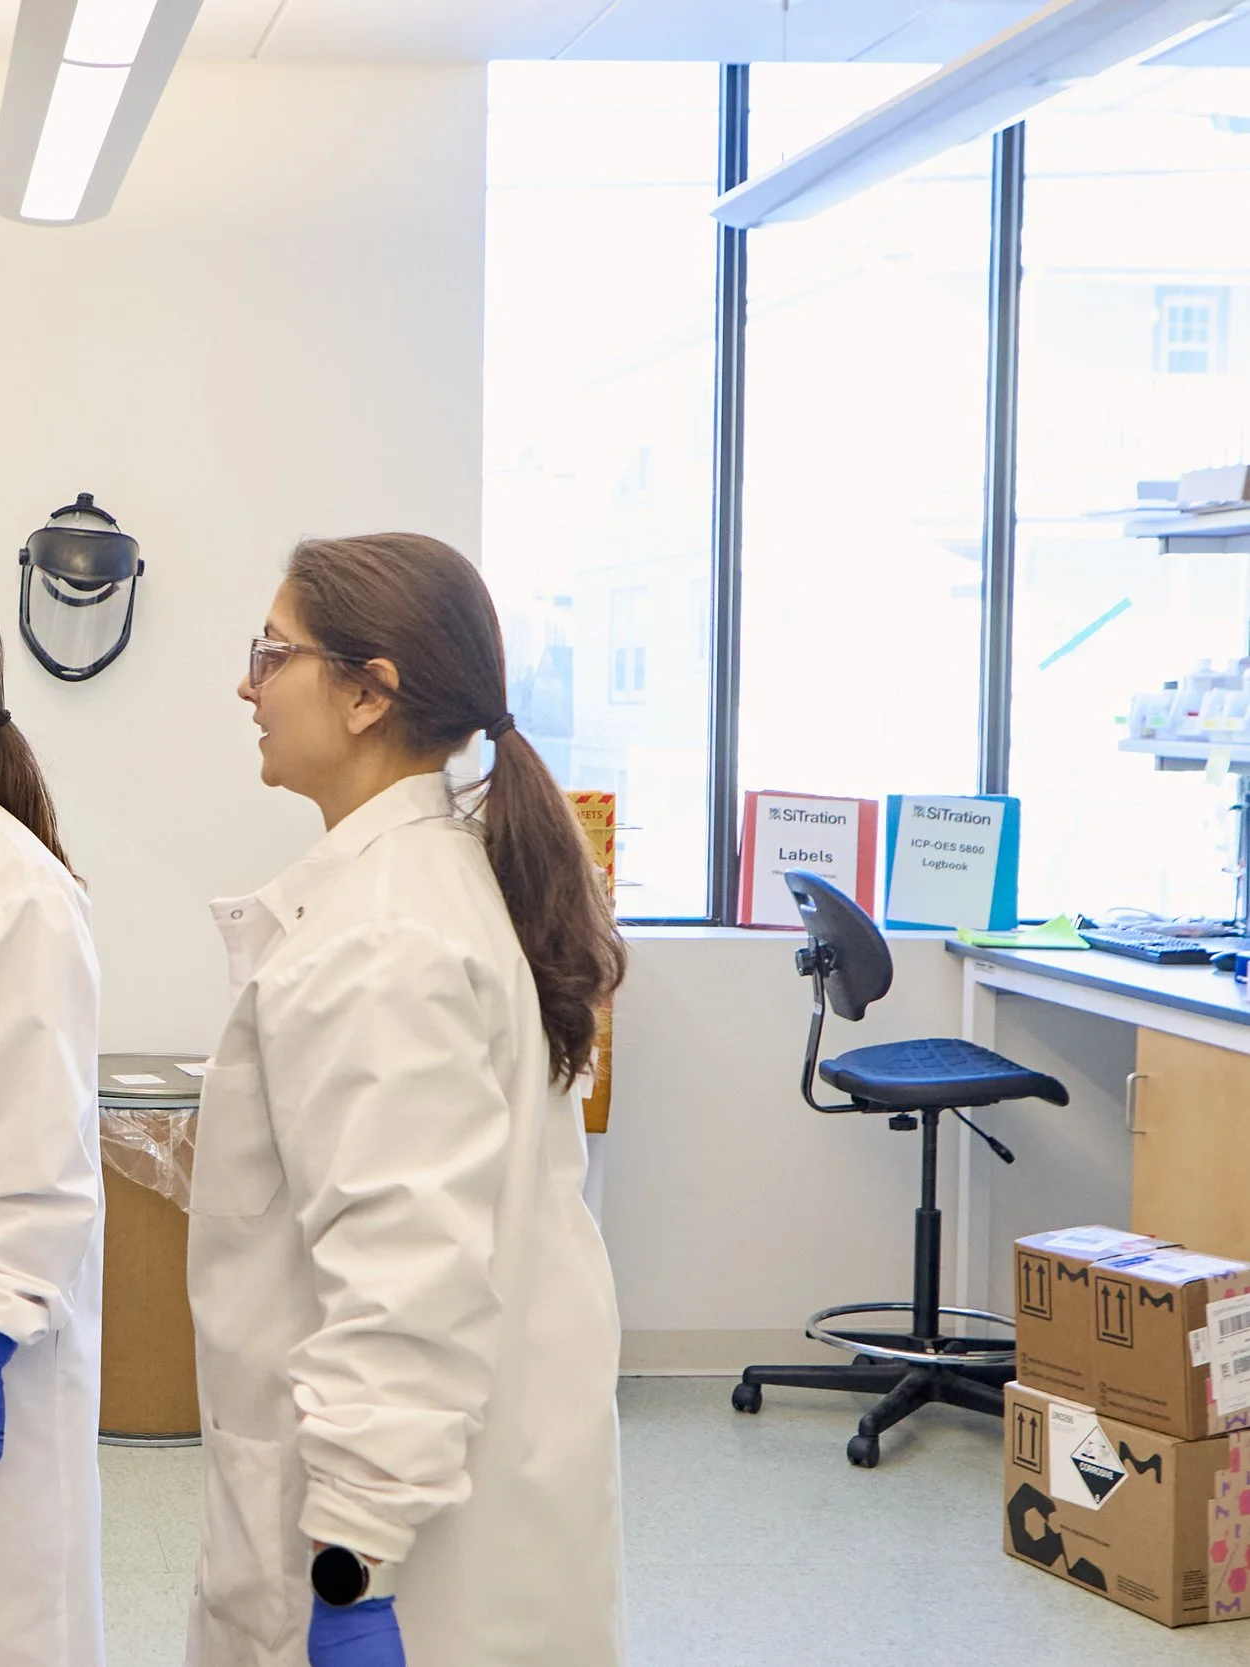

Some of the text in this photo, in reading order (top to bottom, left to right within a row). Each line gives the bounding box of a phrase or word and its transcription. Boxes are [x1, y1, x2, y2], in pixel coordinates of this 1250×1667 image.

[783, 808, 847, 825] SiTration
[926, 807, 991, 826] SiTration
[779, 847, 833, 863] Labels
[911, 838, 985, 855] ICP-OES 5800
[922, 858, 968, 871] Logbook
